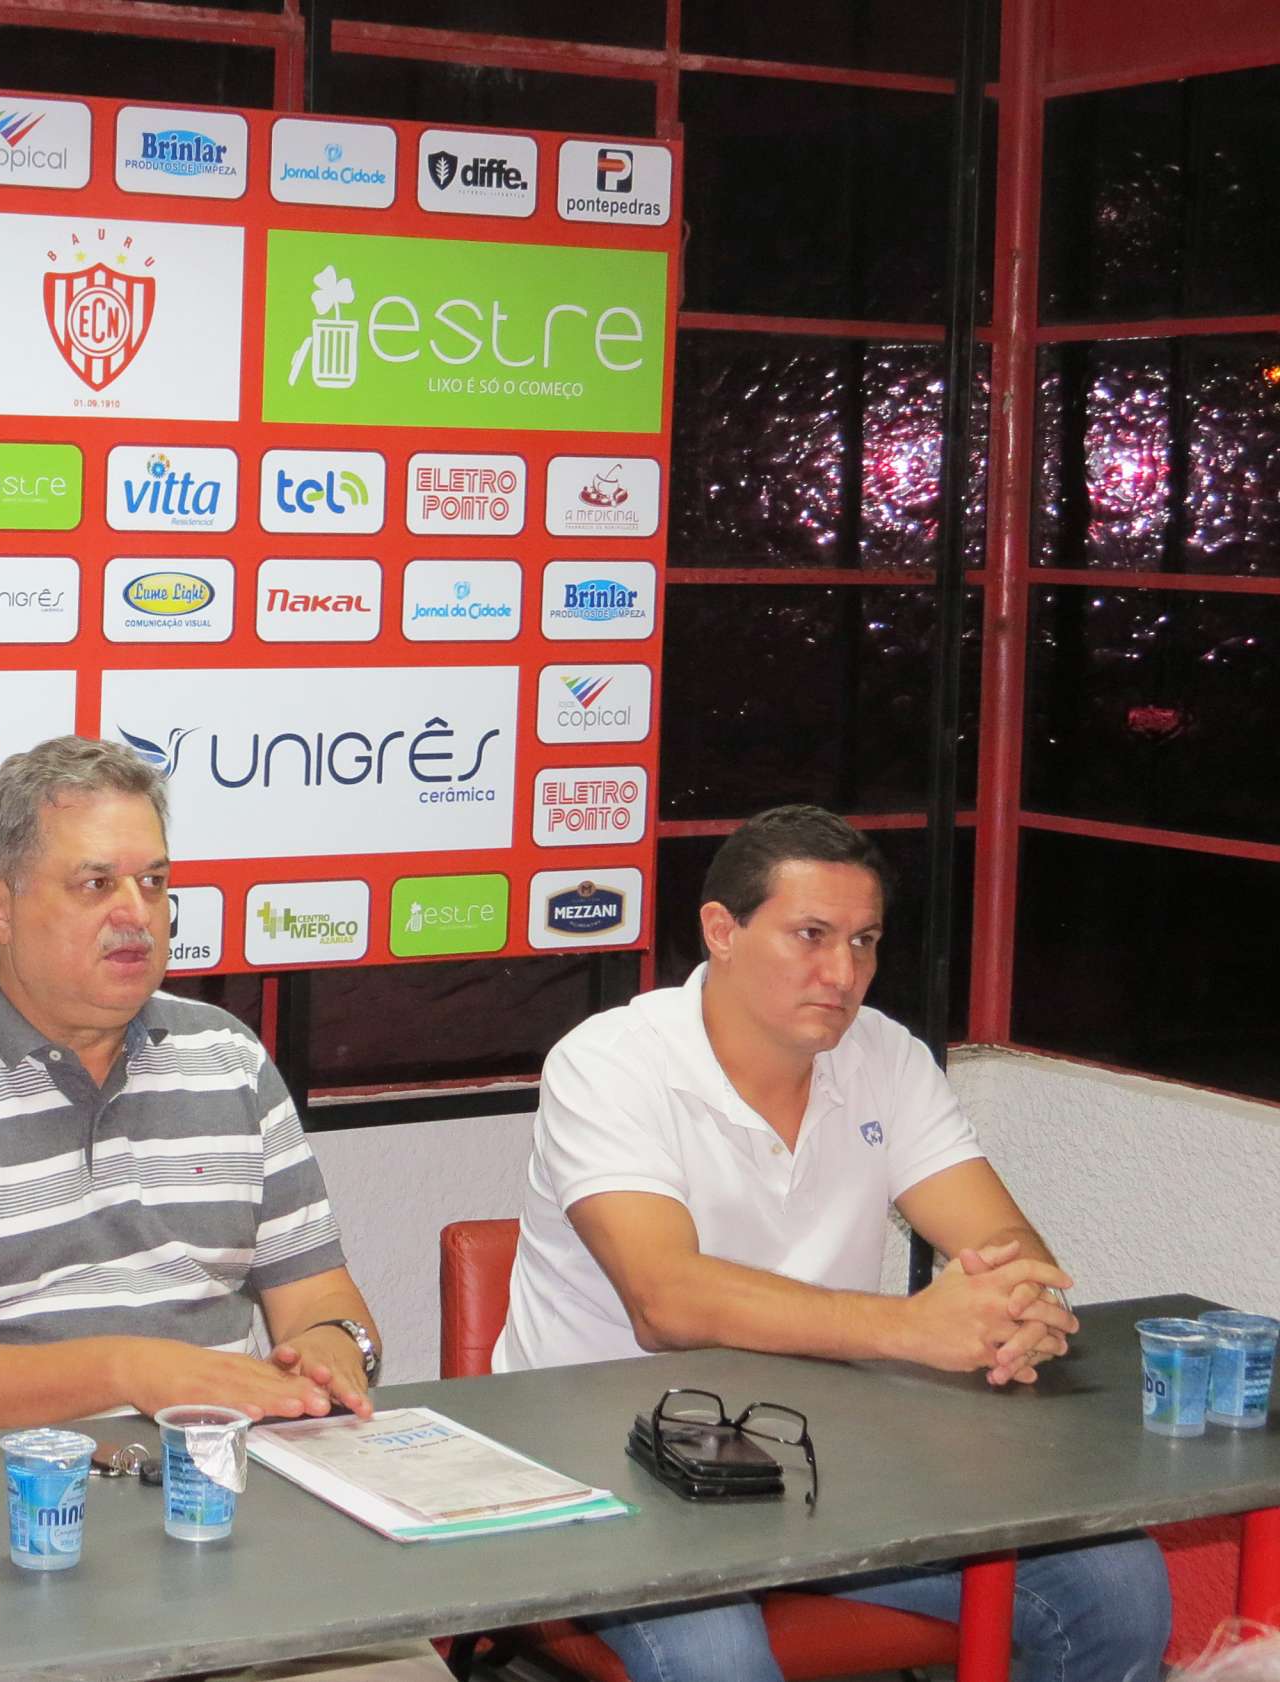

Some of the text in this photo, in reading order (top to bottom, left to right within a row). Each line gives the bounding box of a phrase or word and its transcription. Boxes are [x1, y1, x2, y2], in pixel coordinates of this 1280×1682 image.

[141, 131, 227, 164] Brinlar
[124, 158, 238, 177] PRODUTOS DE LIMPEZA
[280, 163, 386, 185] Jornal da Cidade
[461, 157, 528, 190] diffe.
[566, 195, 661, 218] pontepedras
[48, 228, 156, 267] BAURU
[78, 297, 119, 344] ECN
[368, 295, 643, 372] estre
[428, 375, 583, 399] LIXO É SÓ O COMEÇO
[277, 470, 345, 514] tel
[417, 467, 516, 495] ELETRO
[123, 471, 220, 516] vitta
[423, 494, 509, 521] PONTO
[576, 509, 639, 523] MEDICINAL
[132, 584, 205, 604] Lume Light
[564, 584, 638, 610] Brinlar
[412, 602, 512, 620] Jornal da Cidade
[549, 610, 596, 620] PRODUTOS
[125, 618, 212, 629] COMUNICAÇÃO VISUAL
[557, 706, 631, 731] copical
[420, 787, 495, 804] cerâmica
[542, 780, 638, 805] ELETRO
[548, 806, 631, 832] PONTO
[298, 914, 330, 923] CENTRO
[424, 904, 494, 925] estre
[554, 904, 617, 921] MEZZANI
[291, 921, 358, 939] MEDICO
[320, 935, 353, 945] AZARIAS
